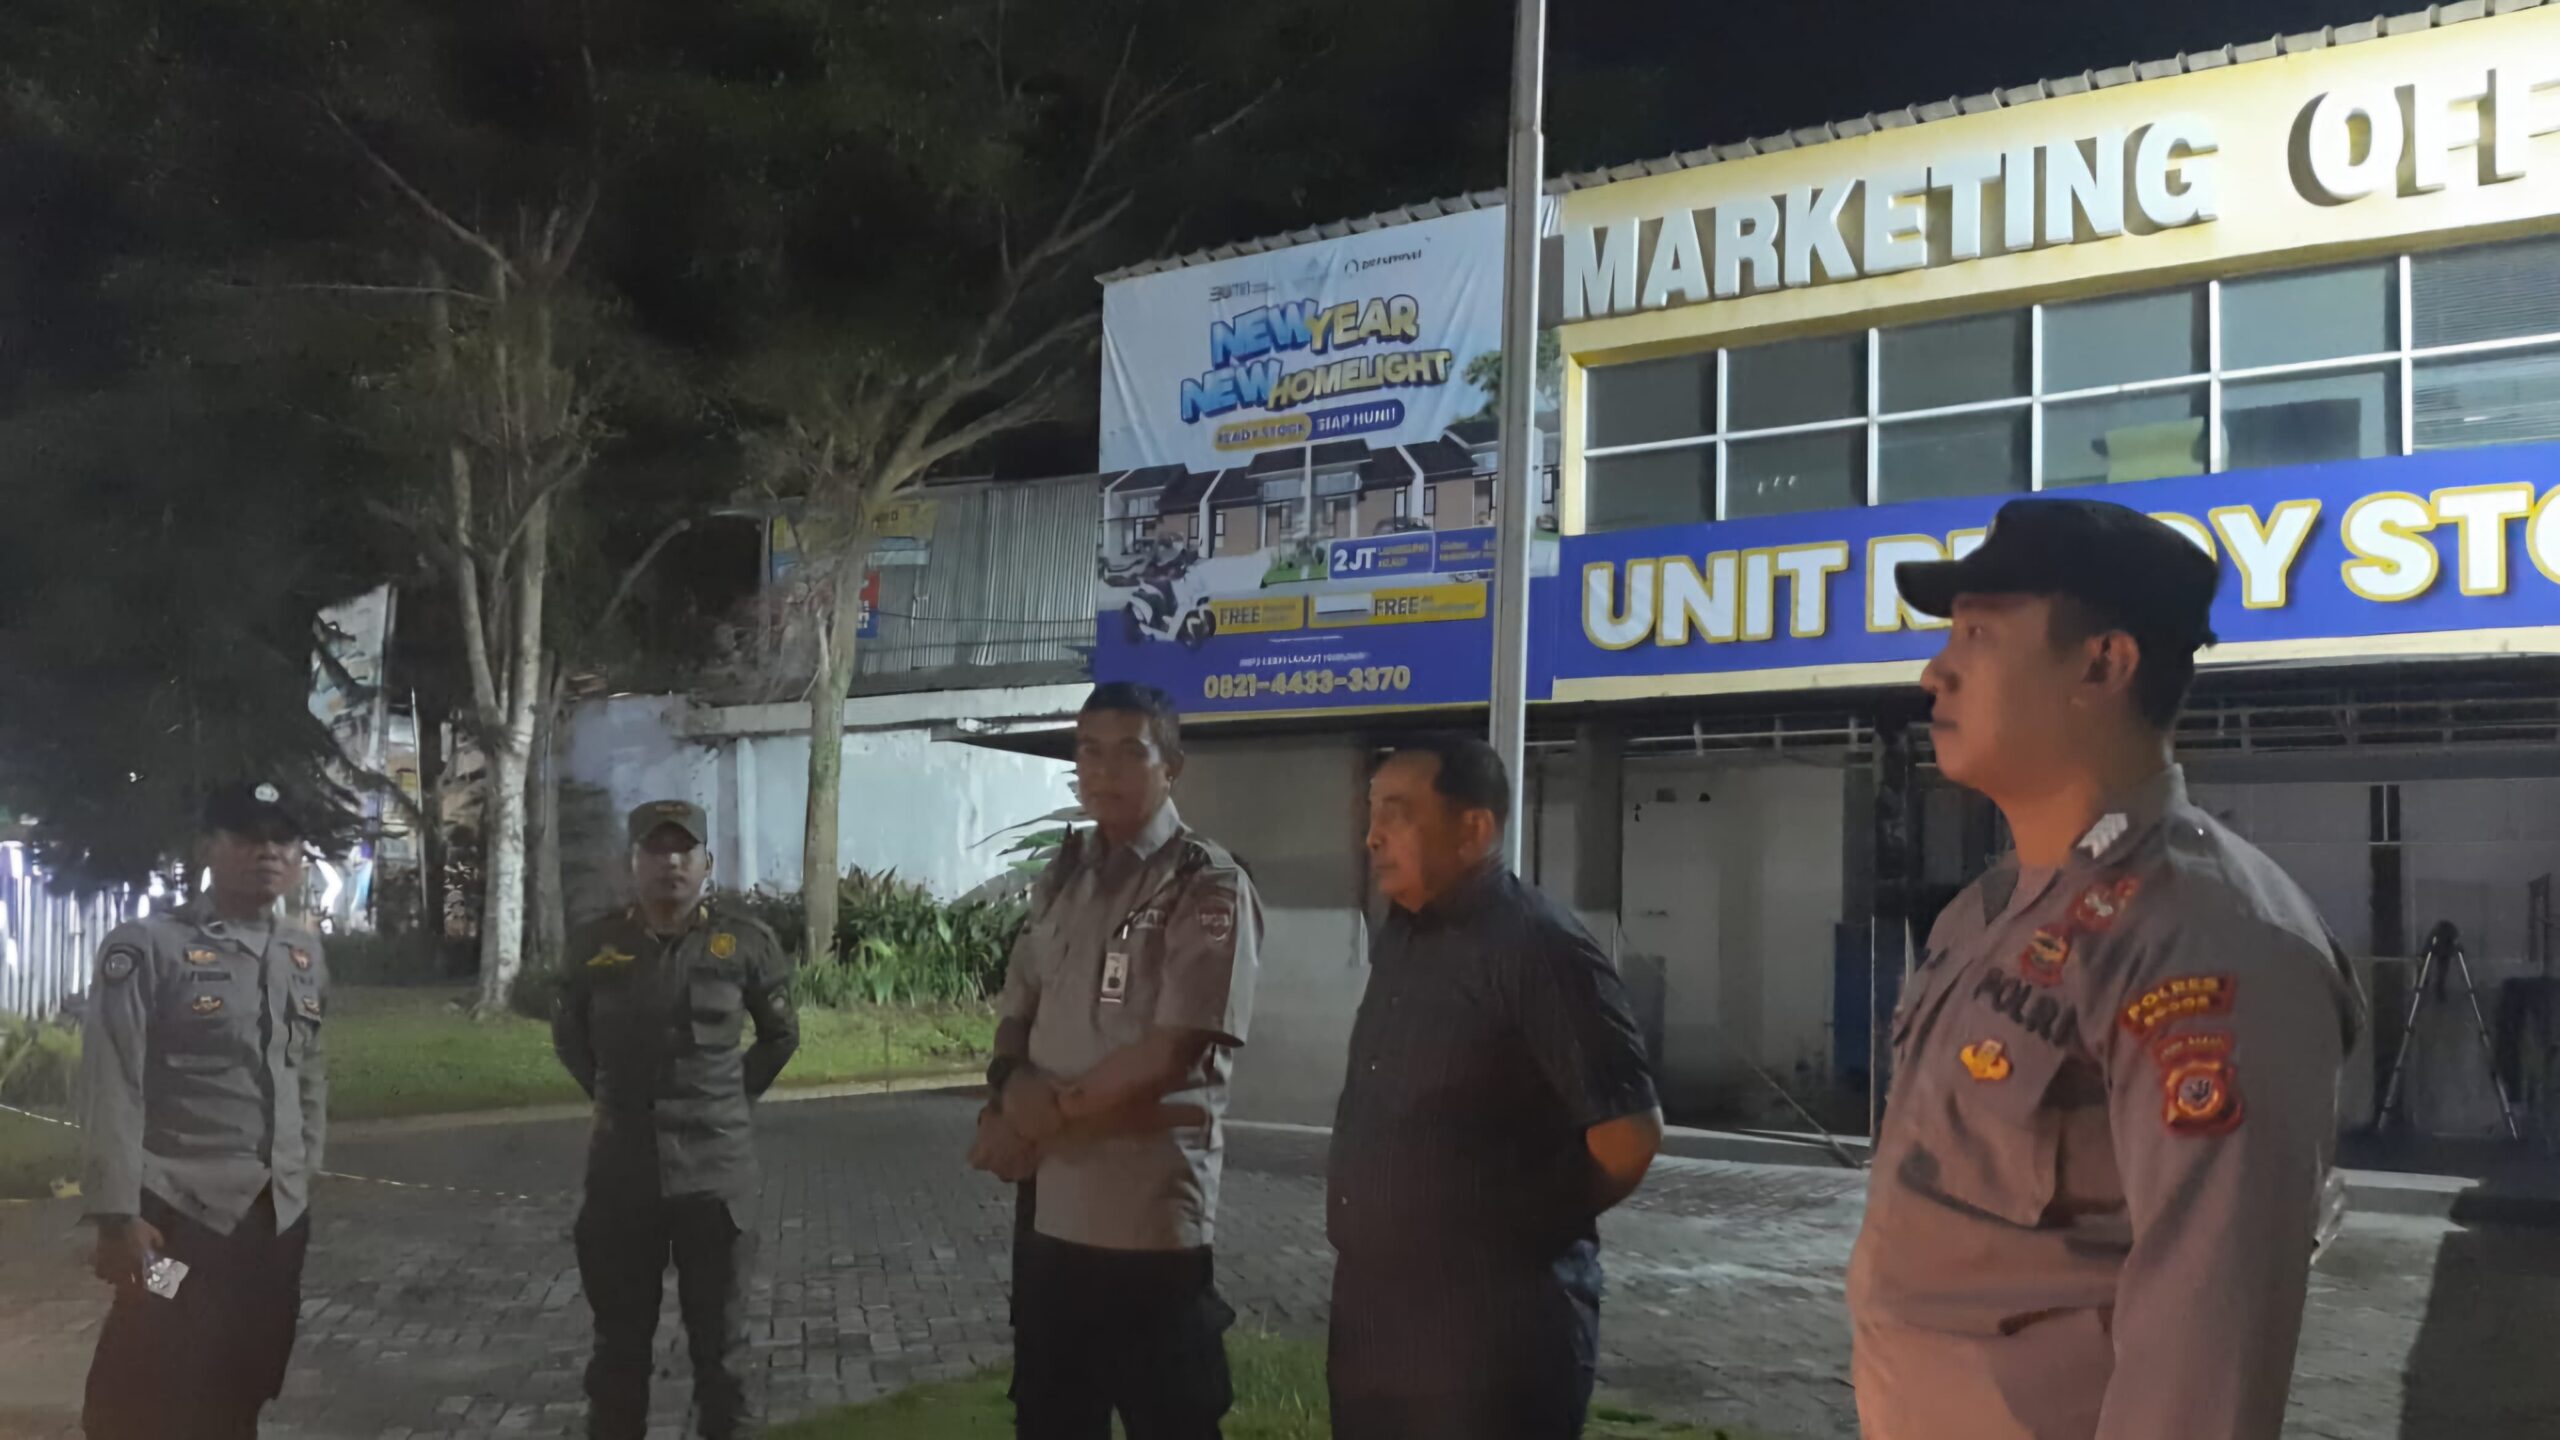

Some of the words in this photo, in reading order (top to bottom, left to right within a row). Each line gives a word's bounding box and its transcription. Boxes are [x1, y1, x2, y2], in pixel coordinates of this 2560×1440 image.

[1563, 119, 2219, 319] MARKETING
[1210, 298, 1318, 371] NEW
[1305, 293, 1420, 355] YEAR
[1180, 357, 1283, 424] NEW
[1264, 348, 1453, 412] HOMELIGHT
[1220, 605, 1261, 626] FREE
[1374, 595, 1420, 617] FREE
[1582, 539, 1849, 651] UNIT
[2127, 976, 2220, 1022] POLRES
